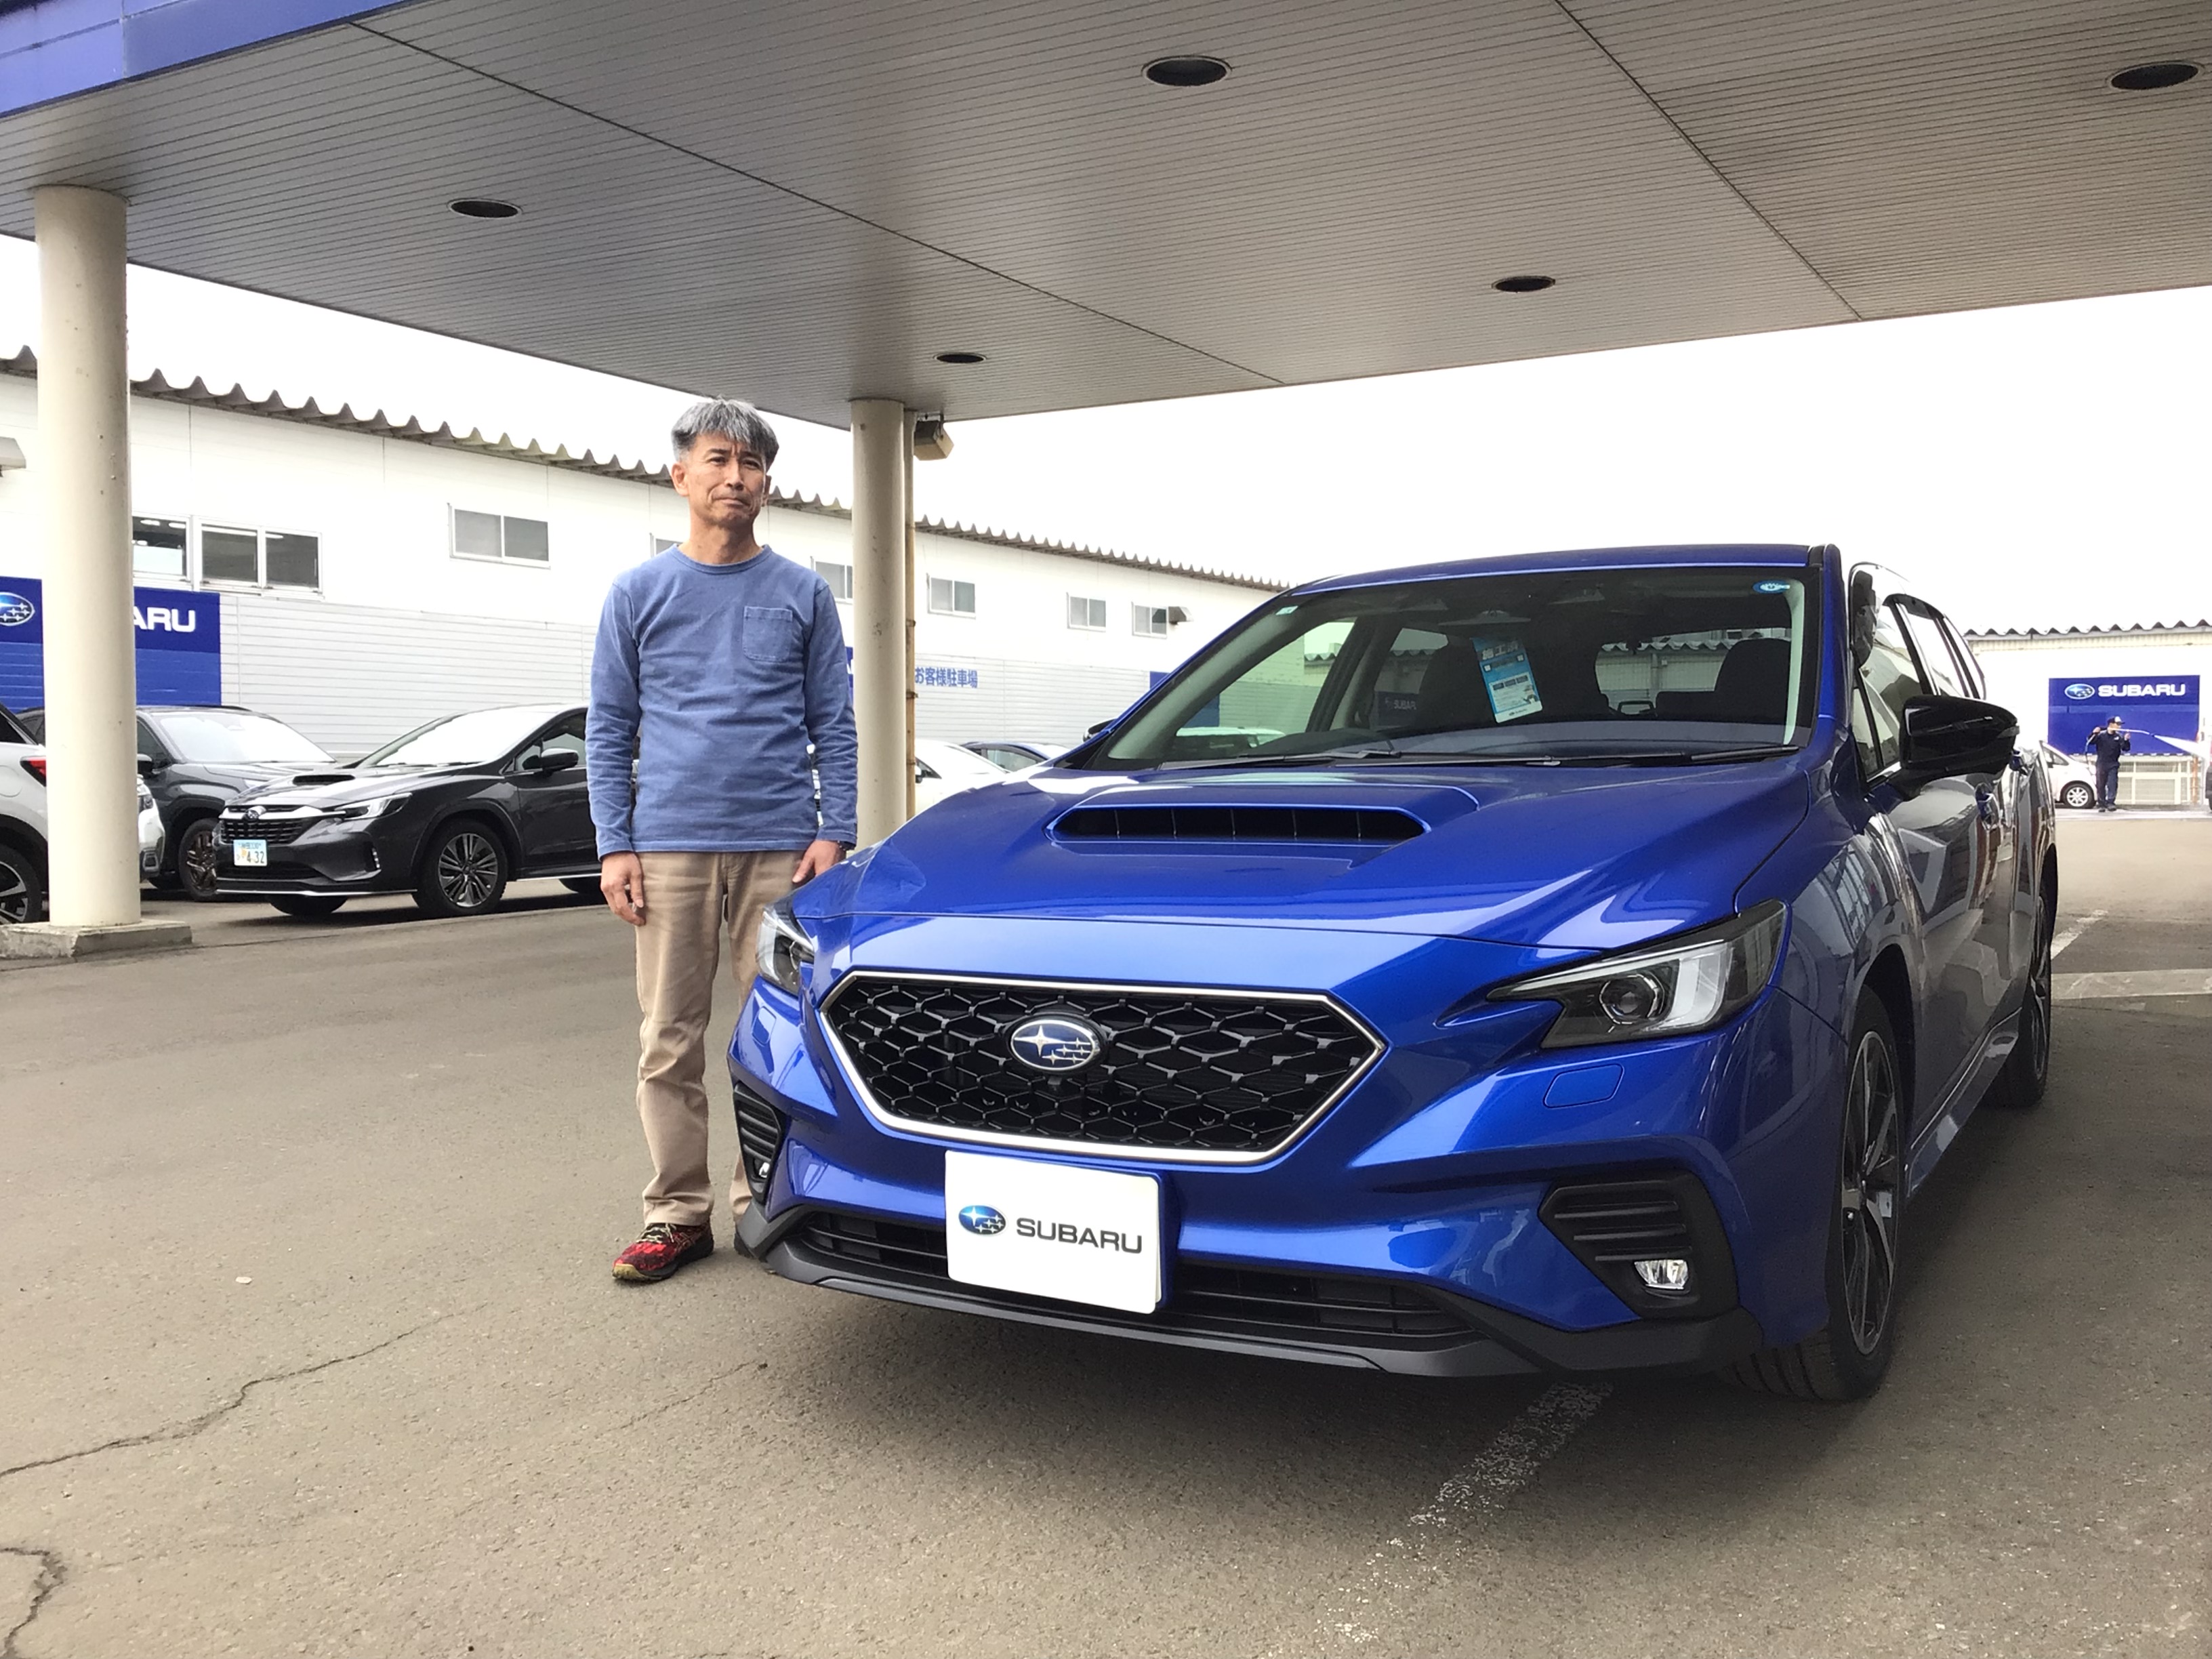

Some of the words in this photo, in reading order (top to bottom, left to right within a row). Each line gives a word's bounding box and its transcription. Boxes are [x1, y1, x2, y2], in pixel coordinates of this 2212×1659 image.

[915, 667, 978, 689] お客様駐車場
[2098, 684, 2186, 697] SUBARU
[1017, 1217, 1142, 1254] SUBARU
